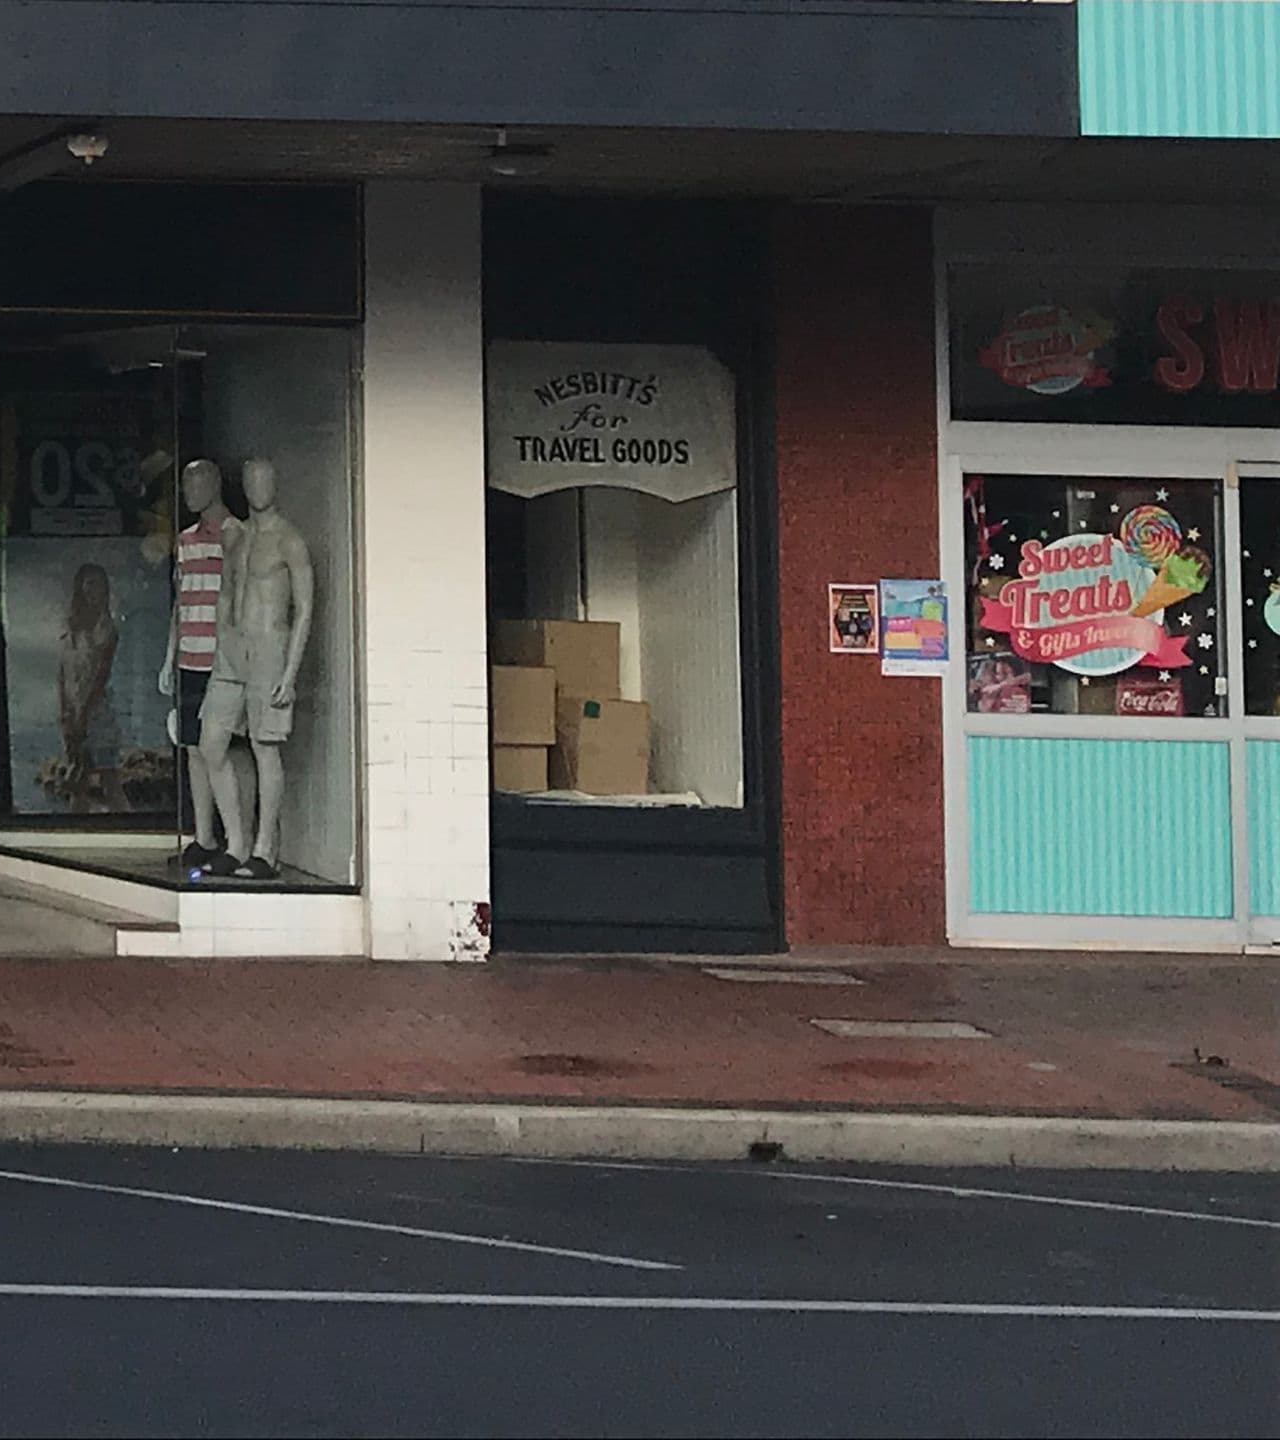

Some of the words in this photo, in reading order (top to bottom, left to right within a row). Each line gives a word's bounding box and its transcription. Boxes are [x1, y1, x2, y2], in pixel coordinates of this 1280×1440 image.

[560, 403, 628, 432] for
[513, 436, 605, 463] TRAVEL
[612, 438, 689, 464] GOODS
[1019, 533, 1114, 578] Sweet
[1000, 574, 1133, 628] Treats
[1017, 629, 1034, 649] &
[1040, 629, 1081, 657] Gifts
